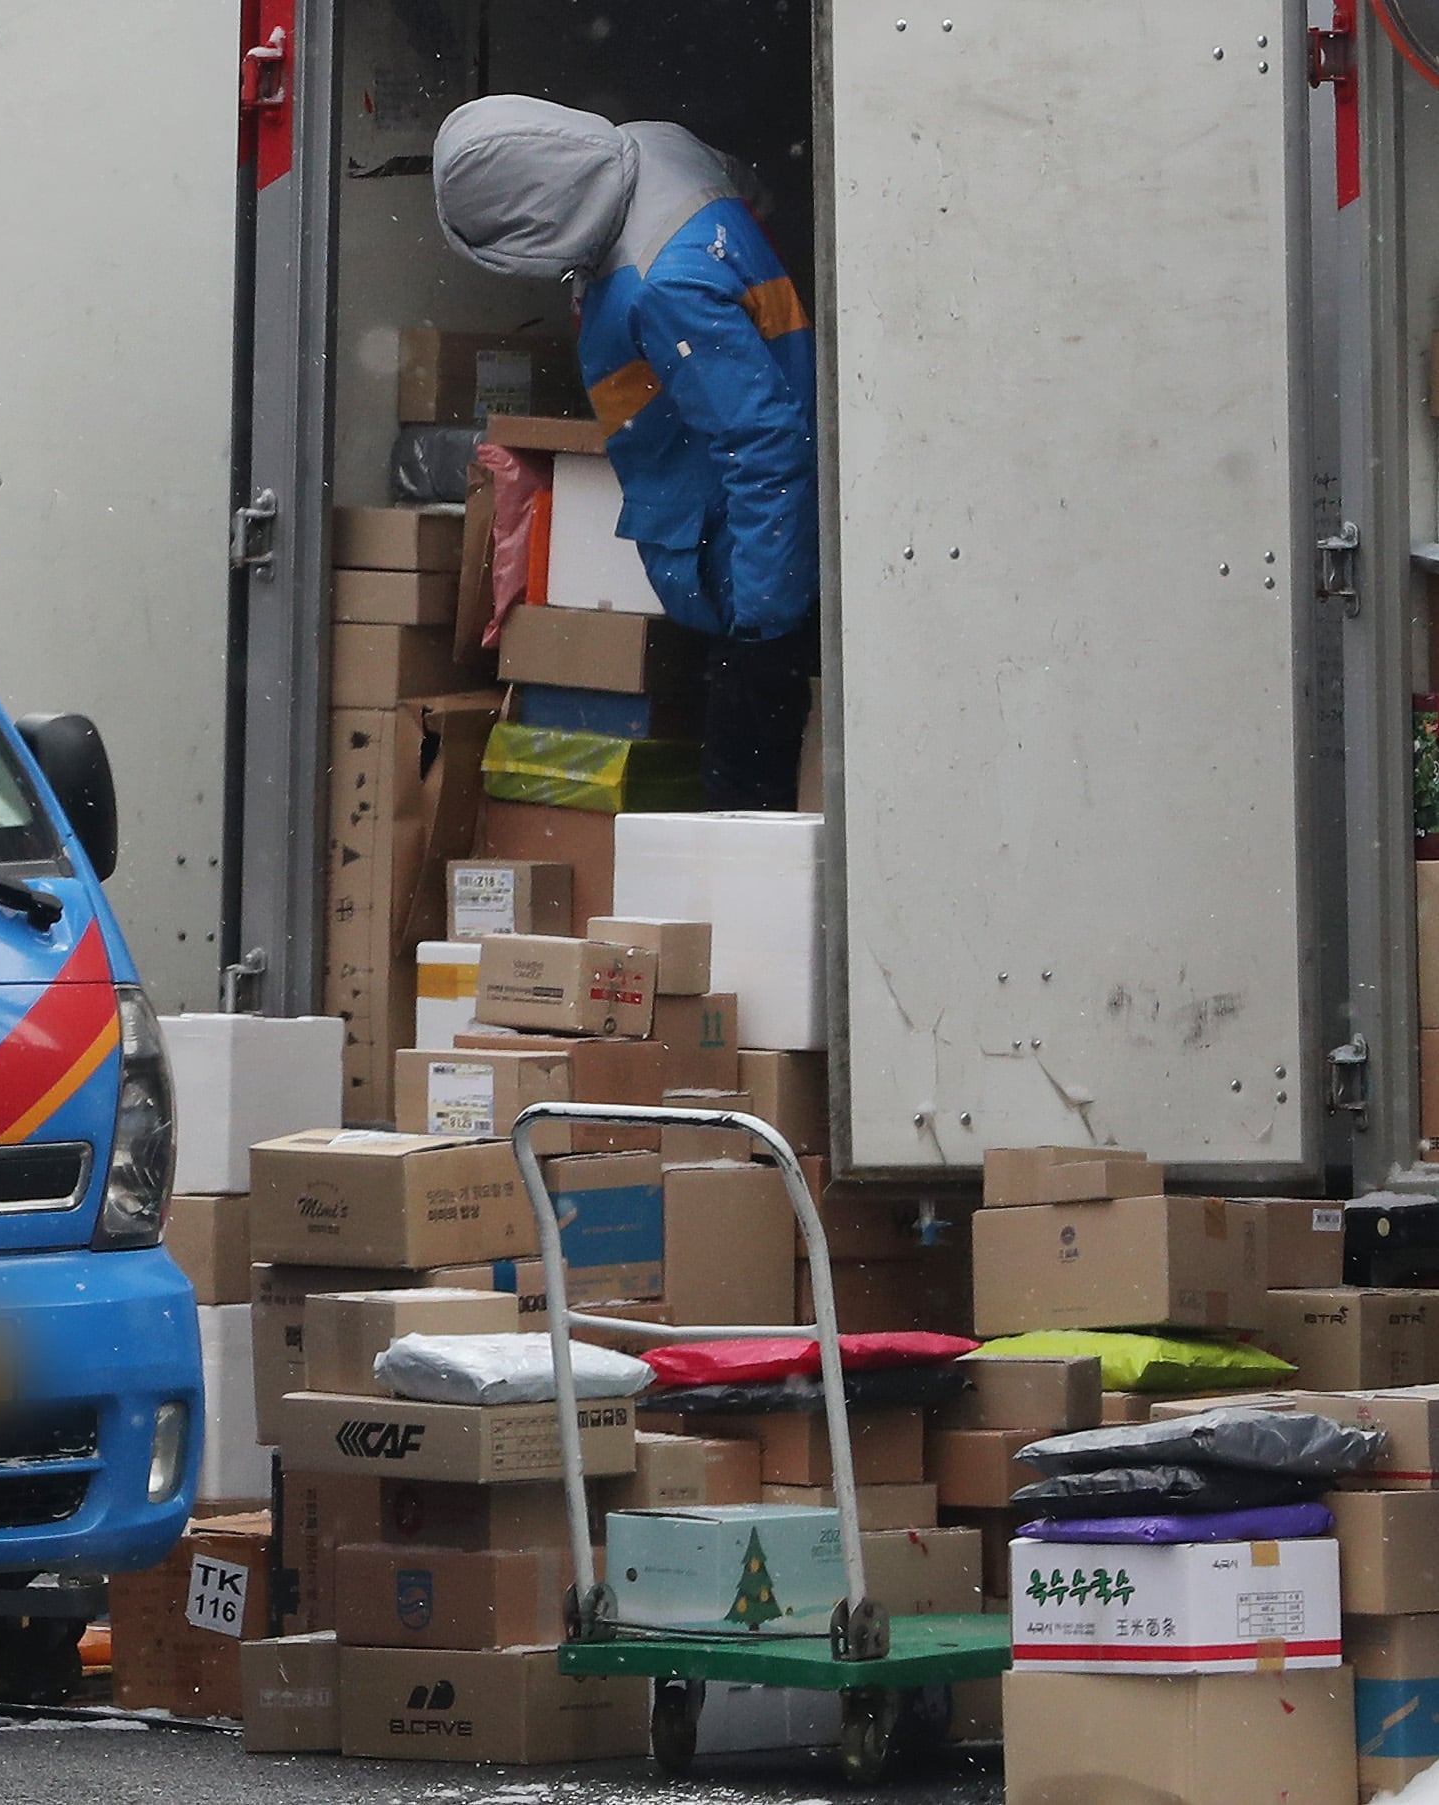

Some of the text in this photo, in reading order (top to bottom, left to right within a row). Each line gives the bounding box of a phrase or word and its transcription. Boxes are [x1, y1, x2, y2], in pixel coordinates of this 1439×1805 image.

[297, 1196, 349, 1218] Mimi's
[196, 1562, 243, 1596] TK
[1025, 1568, 1136, 1608] 옥수수국수
[194, 1593, 237, 1623] 116
[389, 1718, 474, 1737] B.CAVE
